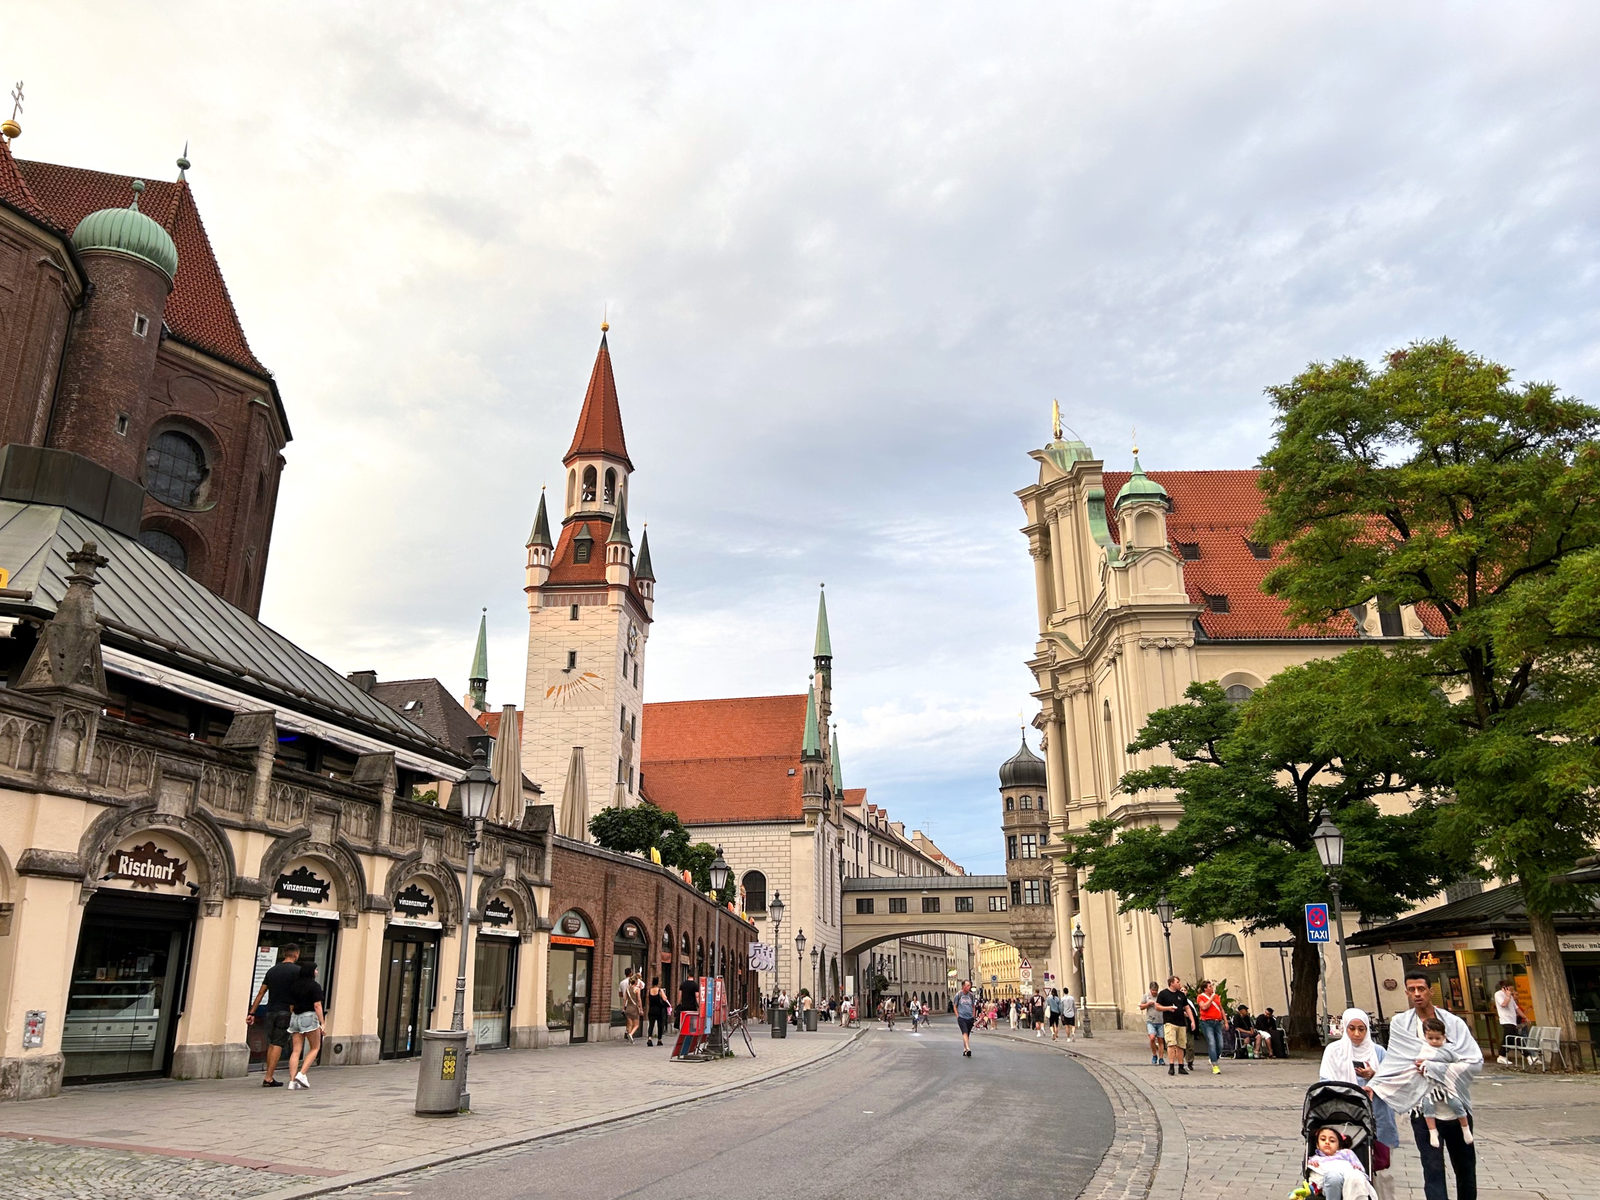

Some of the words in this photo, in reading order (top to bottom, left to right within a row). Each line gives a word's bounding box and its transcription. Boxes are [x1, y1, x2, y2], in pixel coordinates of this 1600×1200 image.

[118, 856, 175, 880] Rischart
[282, 881, 322, 894] vinzenzmurr
[399, 897, 428, 908] vinzenzmurr
[289, 907, 319, 916] vinzenzmurr
[1310, 930, 1328, 939] TAXI
